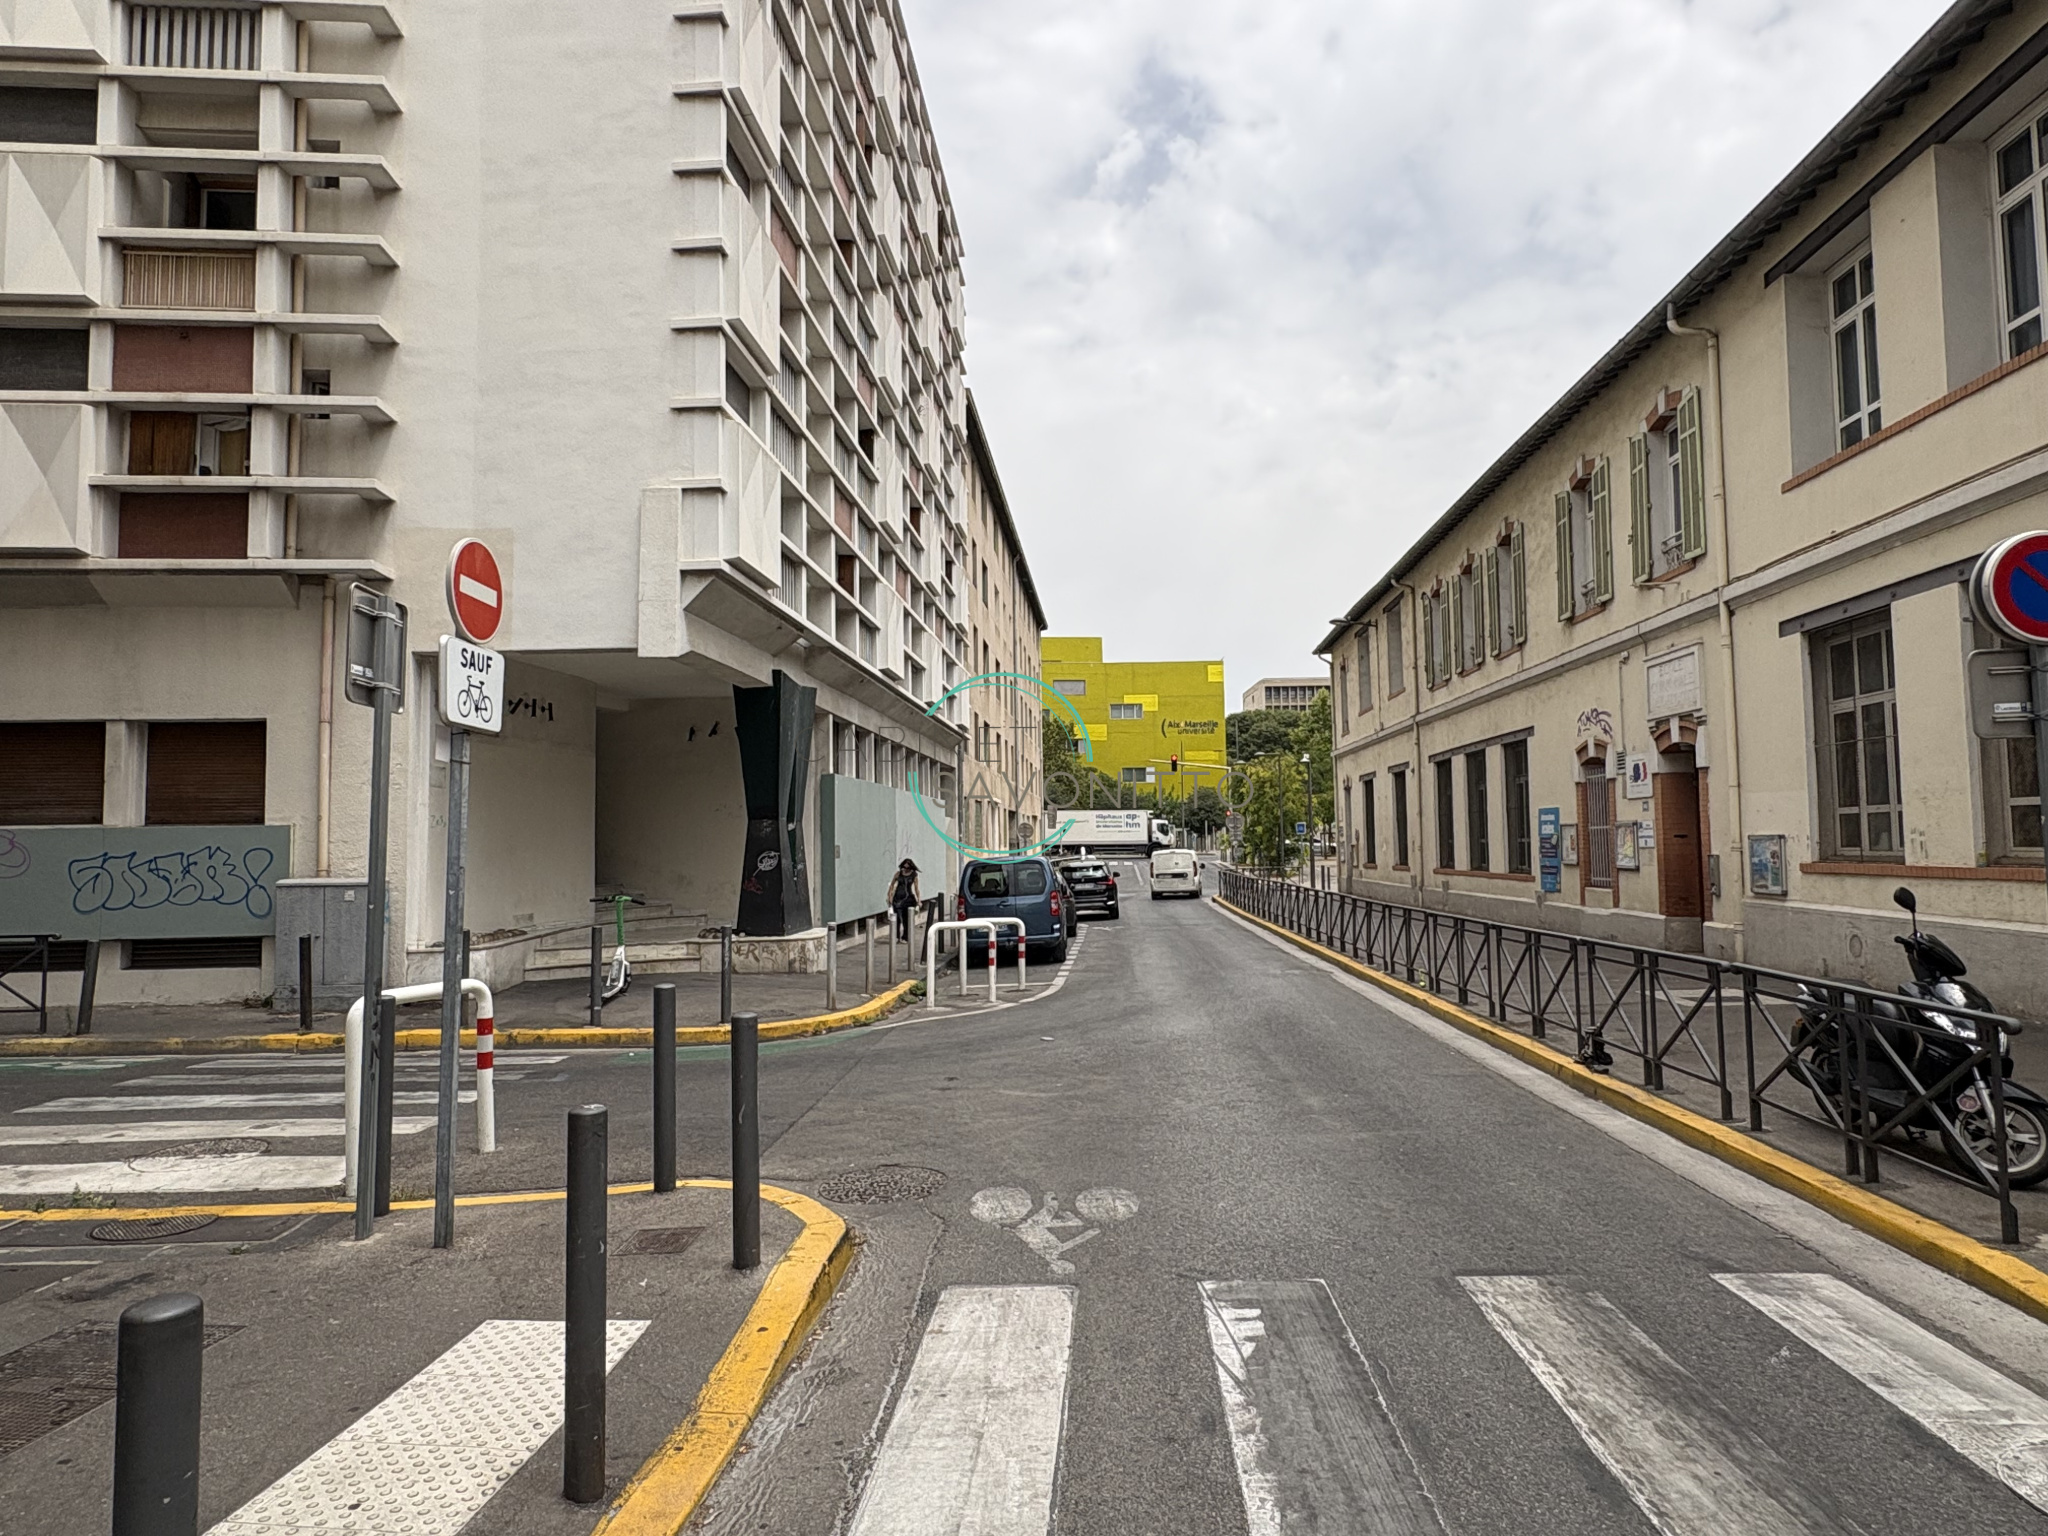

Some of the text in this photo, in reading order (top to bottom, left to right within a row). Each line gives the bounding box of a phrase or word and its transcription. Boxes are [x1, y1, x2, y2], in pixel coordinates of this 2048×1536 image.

[460, 647, 493, 675] SAUF
[1184, 719, 1219, 728] Marseille
[1125, 821, 1141, 829] hm
